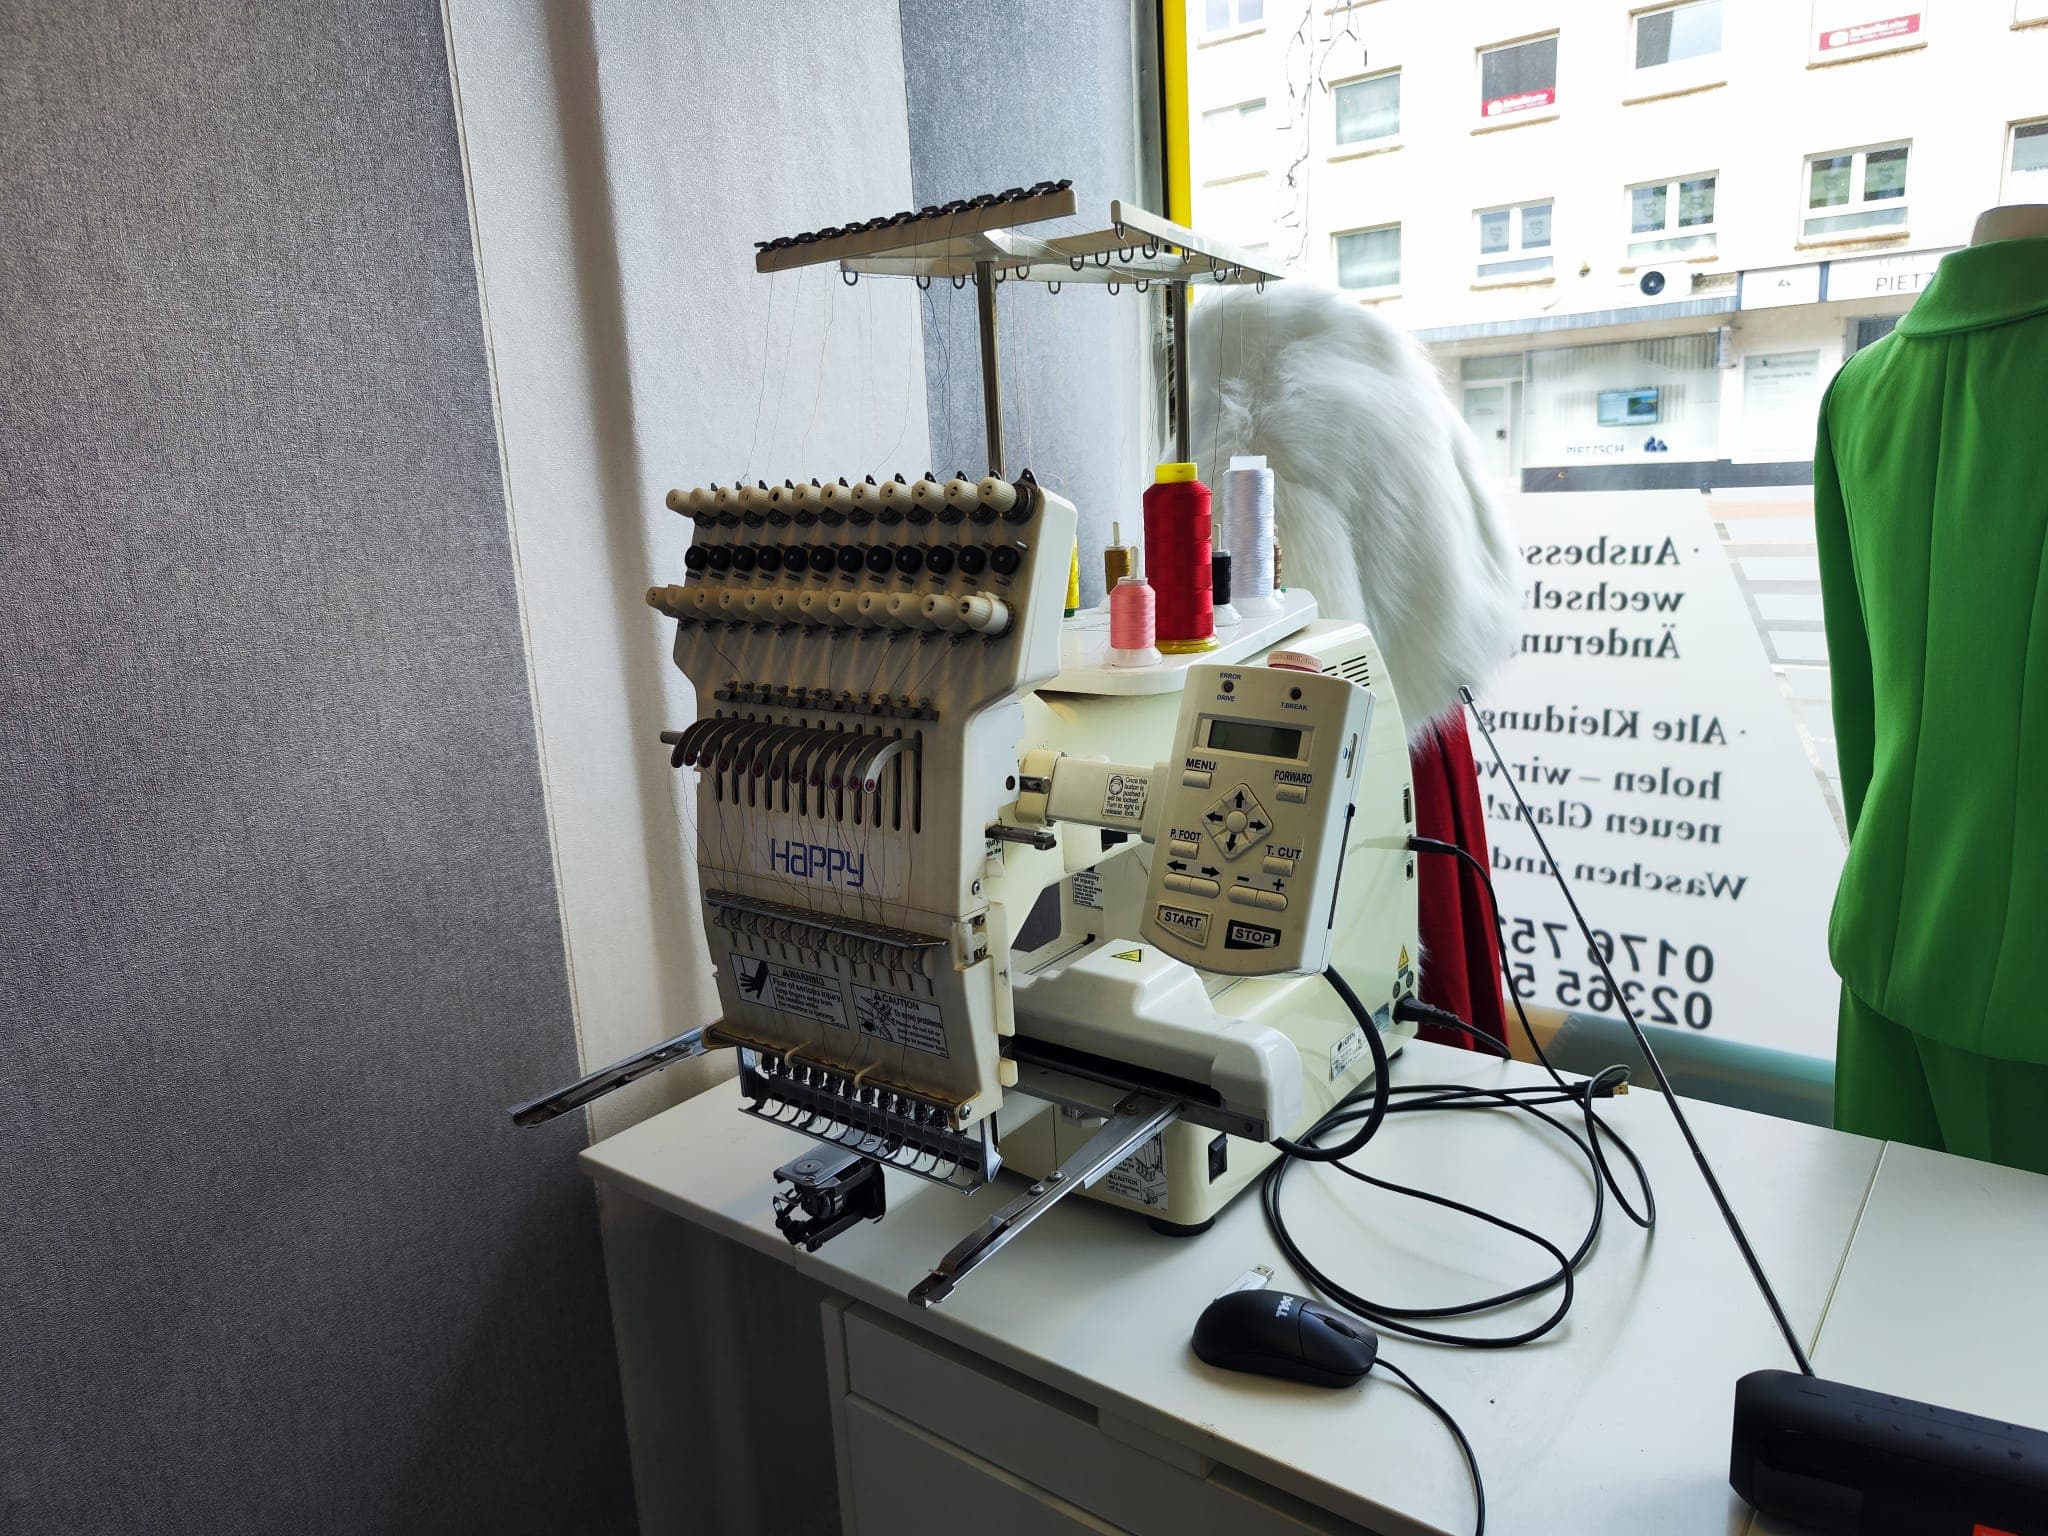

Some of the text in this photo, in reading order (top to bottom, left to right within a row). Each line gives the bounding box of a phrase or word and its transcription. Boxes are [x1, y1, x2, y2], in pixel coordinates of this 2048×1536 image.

[1220, 672, 1241, 680] ERROR
[1216, 694, 1235, 702] DRIVE
[1185, 758, 1216, 771] MENU
[1274, 770, 1312, 784] FORWARD
[1178, 830, 1201, 841] FOOT
[1278, 847, 1302, 859] CUT
[1164, 912, 1201, 928] START
[1236, 929, 1271, 943] STOP
[788, 970, 825, 987] WARNING
[882, 994, 919, 1011] CAUTION
